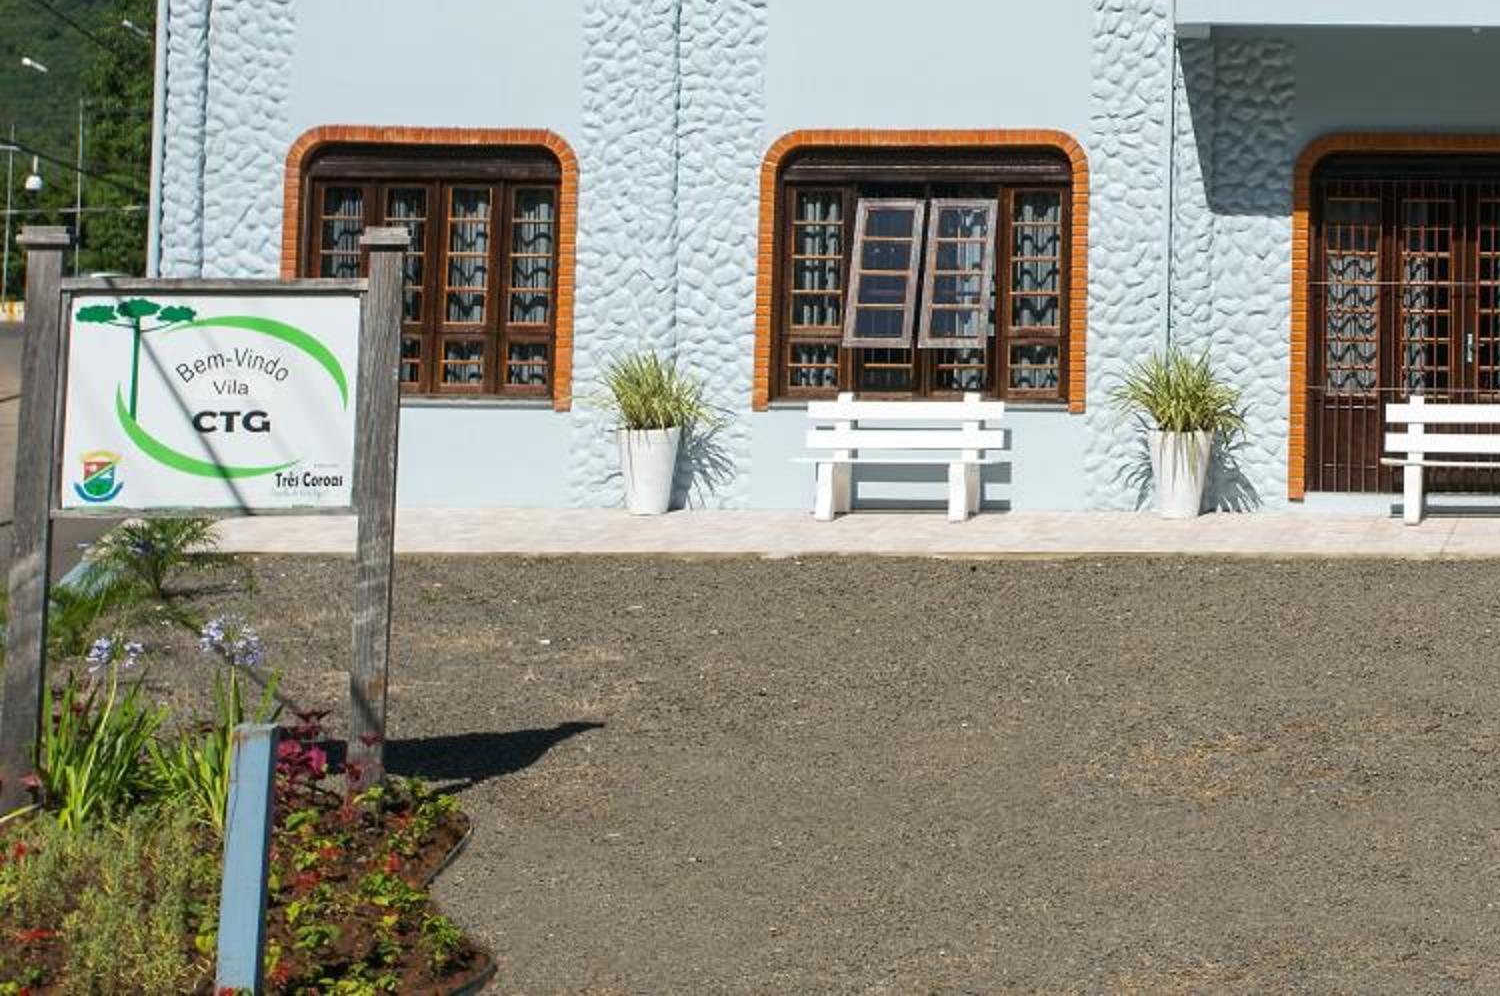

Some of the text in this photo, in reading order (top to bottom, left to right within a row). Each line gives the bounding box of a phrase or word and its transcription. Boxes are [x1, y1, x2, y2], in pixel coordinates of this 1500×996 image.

[176, 348, 289, 383] Bem-Vindo
[213, 380, 249, 395] Vila
[192, 410, 271, 433] CTG
